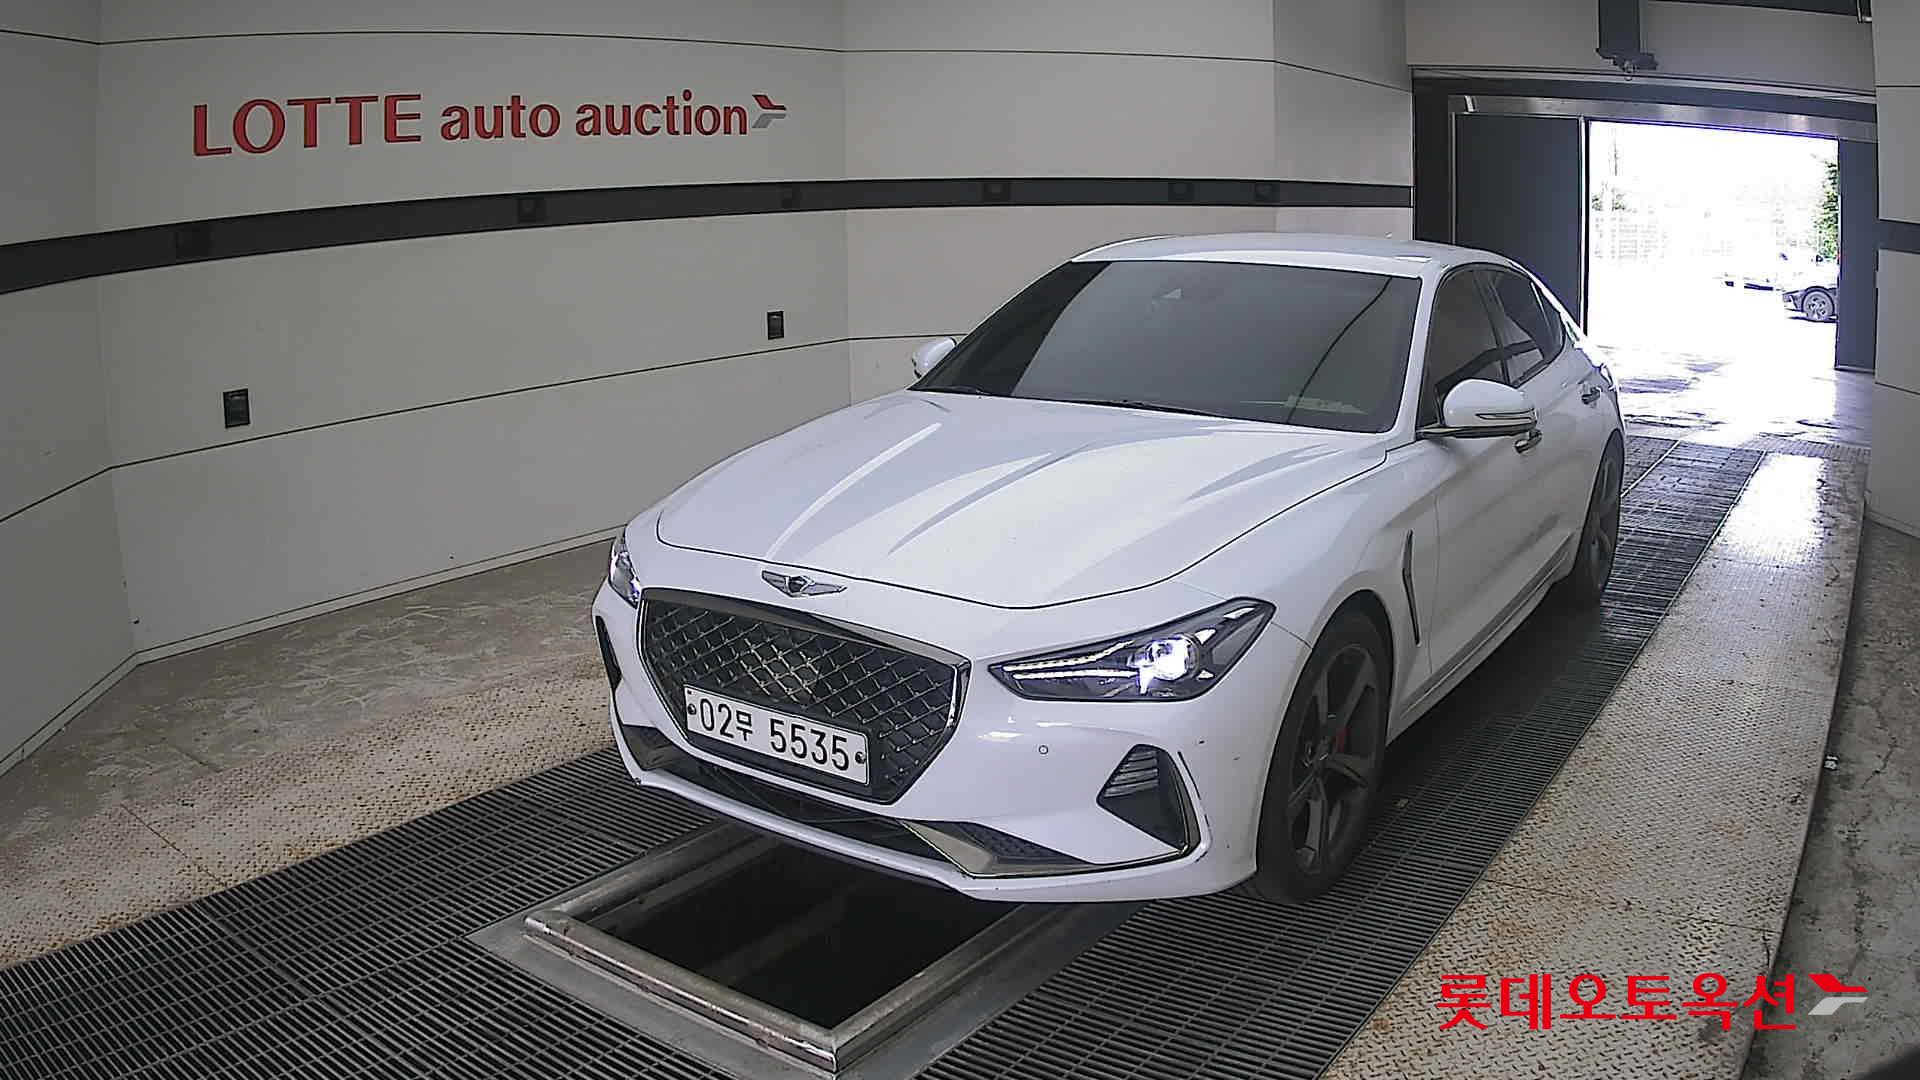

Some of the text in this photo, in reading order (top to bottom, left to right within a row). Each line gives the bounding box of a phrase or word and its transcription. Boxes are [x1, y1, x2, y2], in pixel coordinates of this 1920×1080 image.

[193, 89, 748, 156] LOTTE auto auction
[769, 718, 849, 771] 5535
